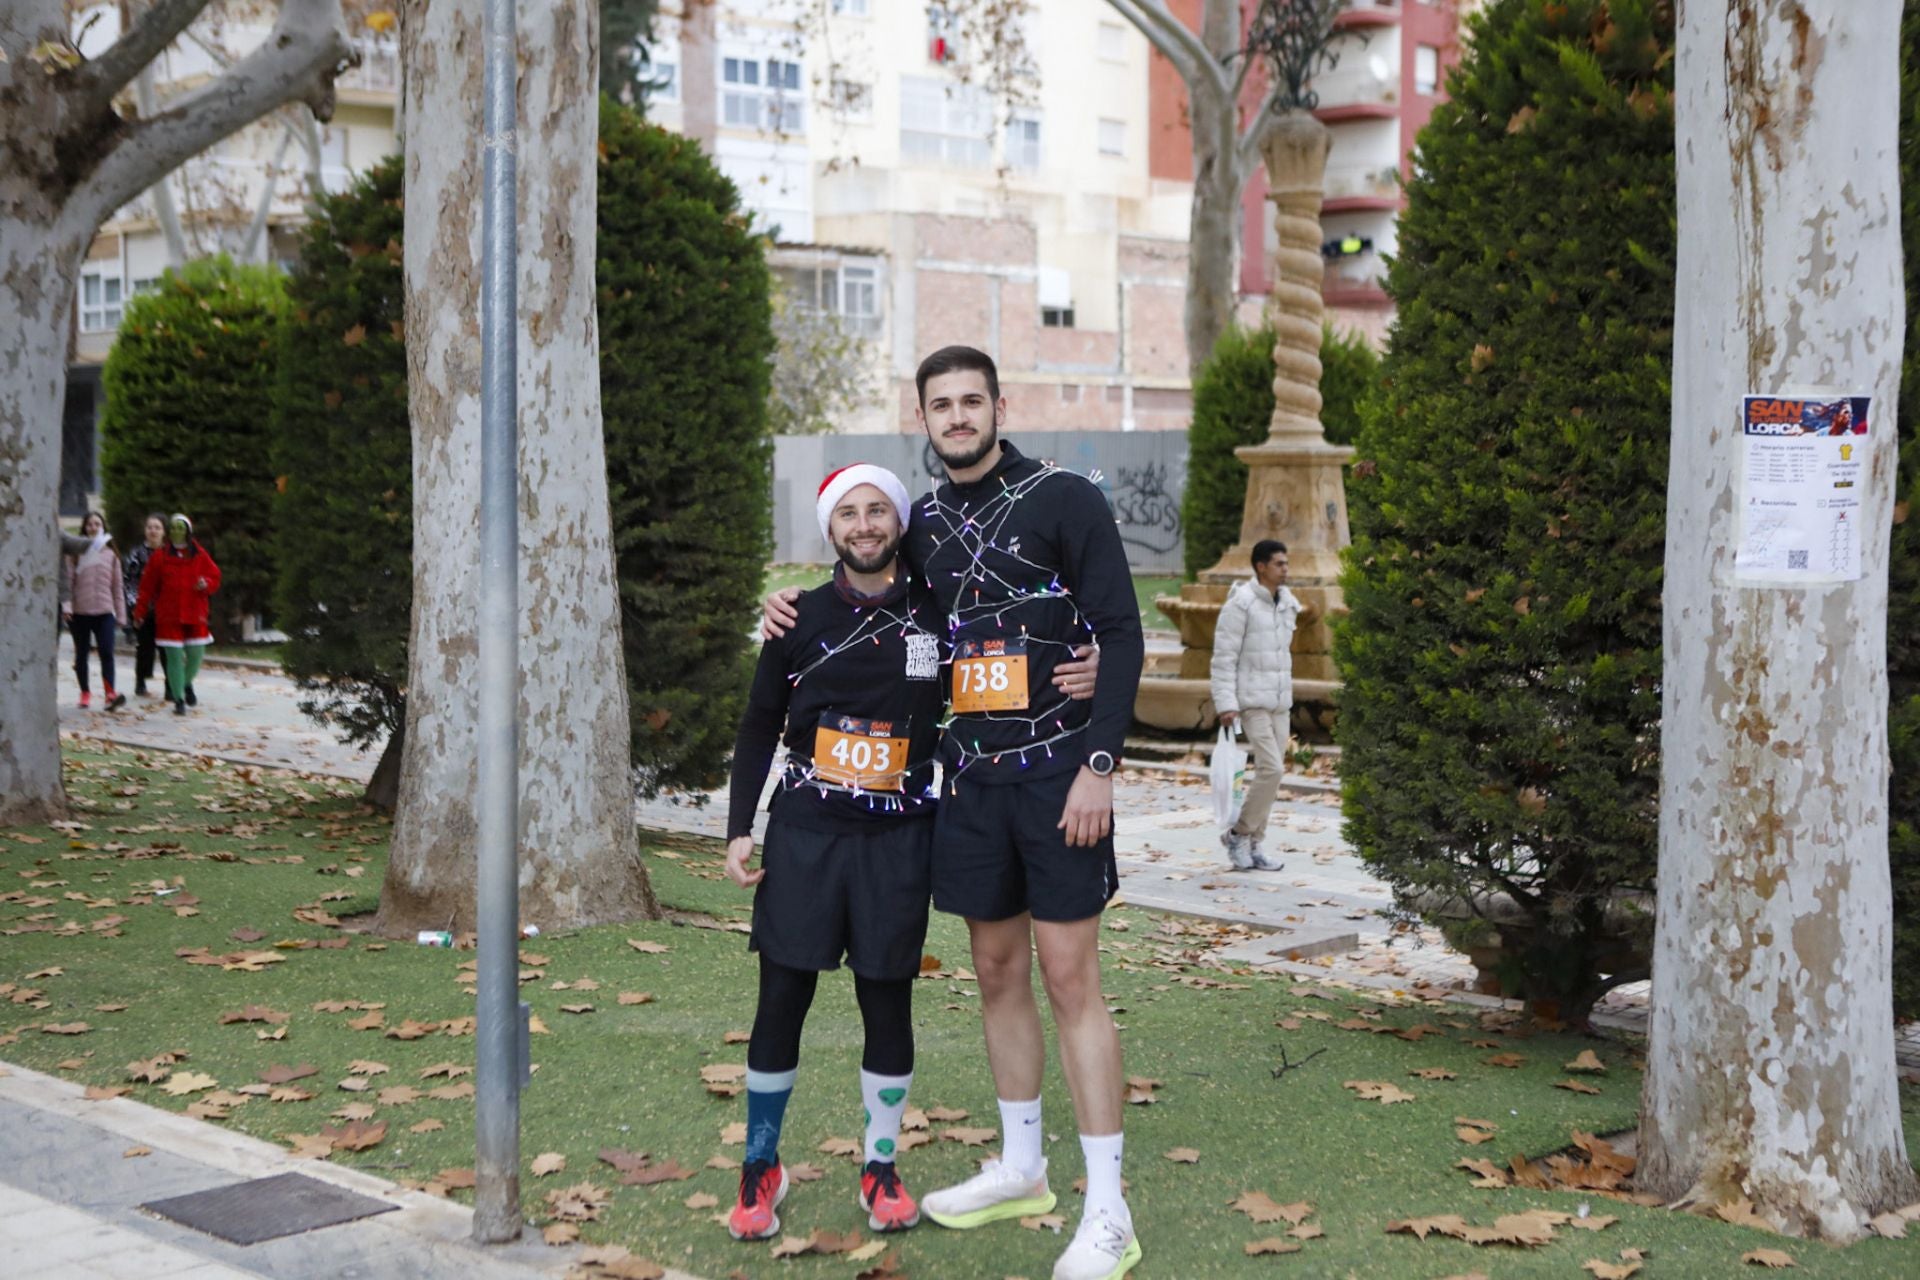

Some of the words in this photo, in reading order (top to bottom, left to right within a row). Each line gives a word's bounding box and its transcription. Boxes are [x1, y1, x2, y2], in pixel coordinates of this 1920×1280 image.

[1749, 399, 1804, 417] SAN
[1749, 423, 1803, 434] LORCA
[983, 640, 1006, 650] SAN
[960, 661, 1009, 694] 738
[870, 721, 893, 731] SAN
[831, 737, 891, 772] 403
